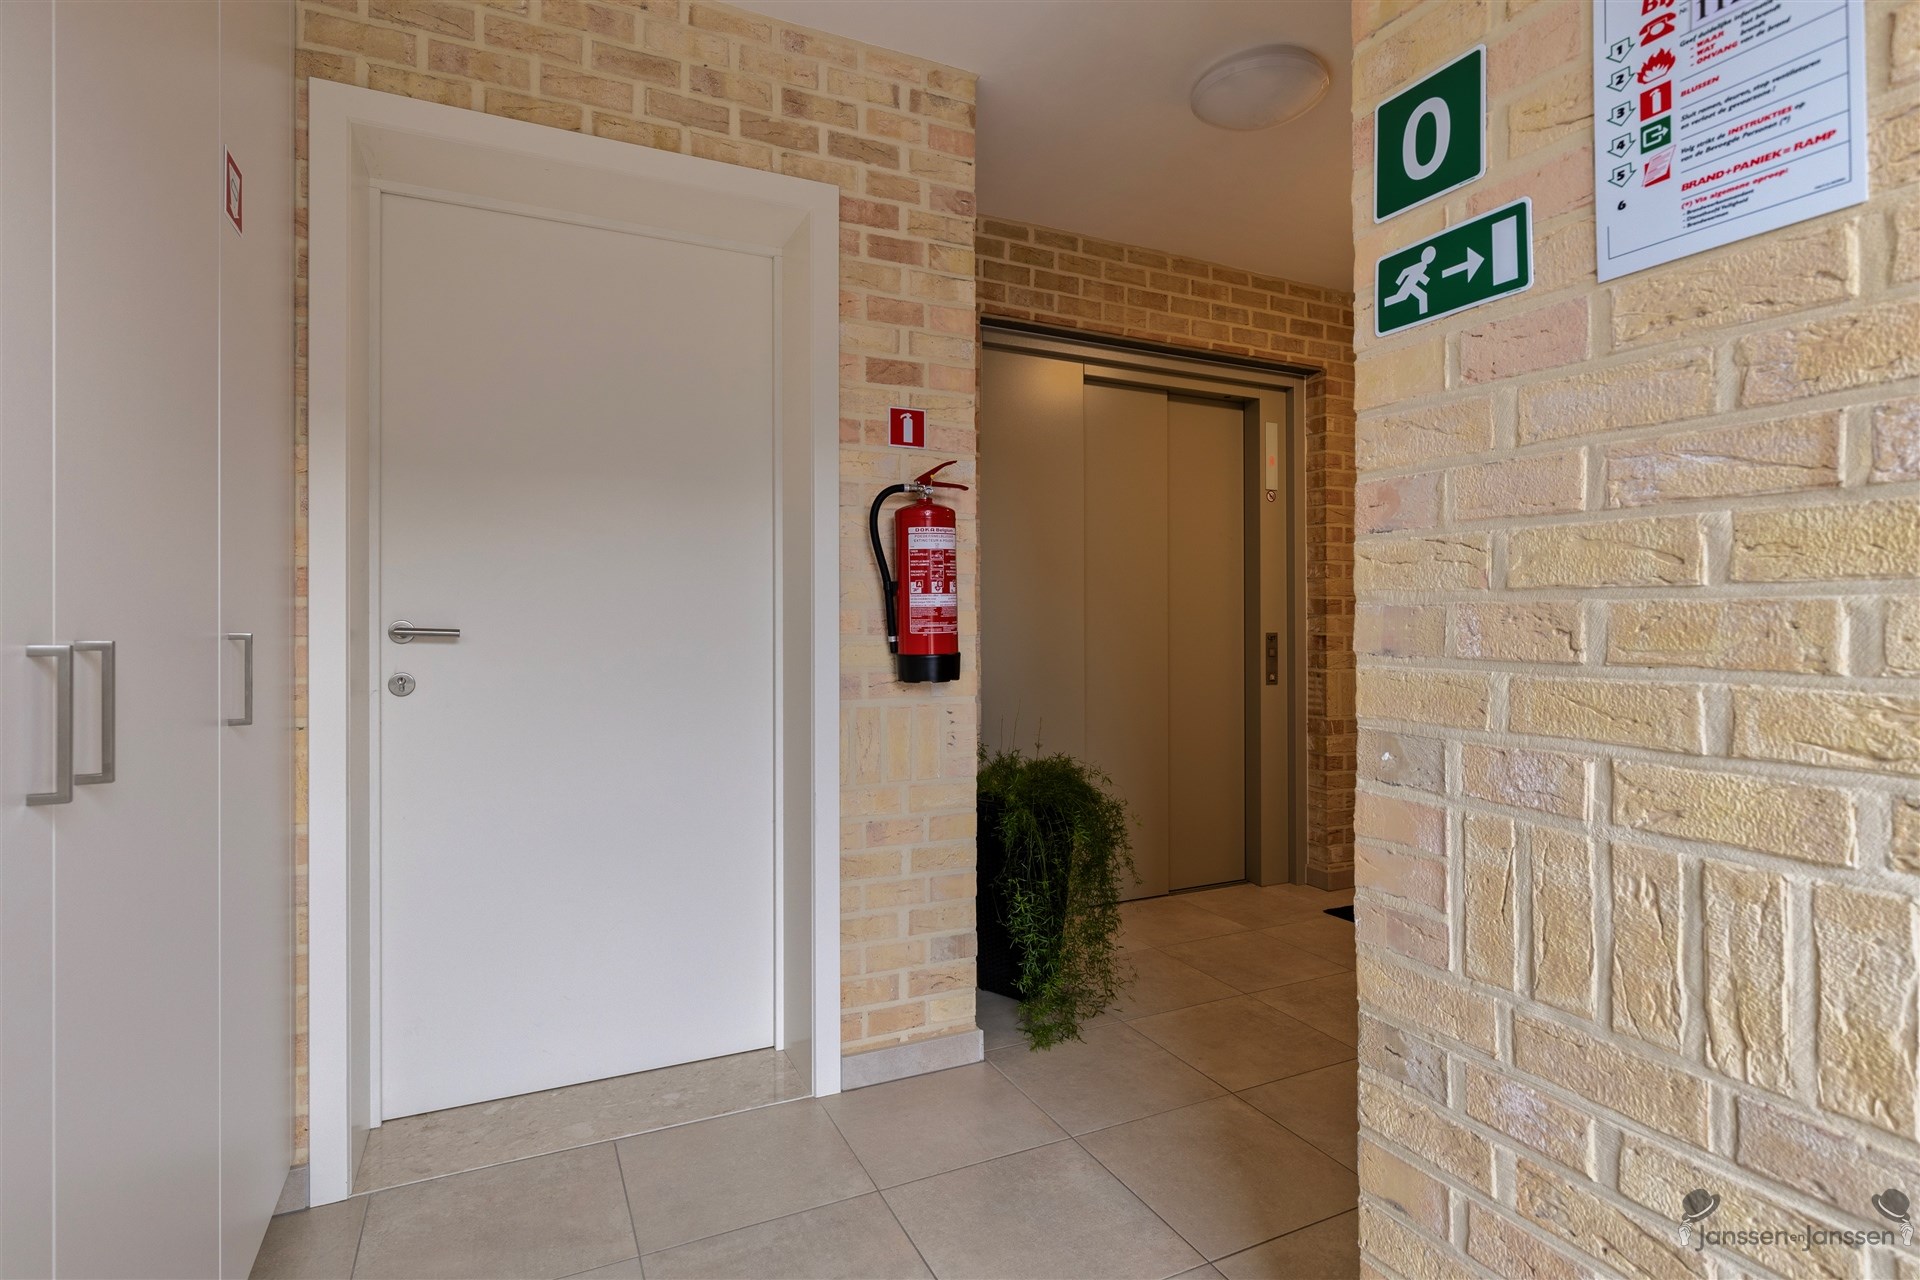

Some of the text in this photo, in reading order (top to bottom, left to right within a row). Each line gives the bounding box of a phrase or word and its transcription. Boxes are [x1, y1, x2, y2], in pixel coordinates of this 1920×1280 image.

[1680, 34, 1697, 47] Geef
[1698, 19, 1732, 38] duidelijke
[1697, 30, 1724, 47] WAAR
[1755, 4, 1781, 20] brandt
[1697, 20, 1765, 56] WAT brandt
[1697, 41, 1738, 64] OMVANG
[1756, 29, 1765, 37] de
[1767, 14, 1791, 31] brand
[1616, 45, 1623, 55] 1
[1615, 74, 1624, 86] 2
[1680, 75, 1720, 97] BLUSSEN
[1616, 107, 1625, 119] 3
[1402, 97, 1450, 180] 0
[1681, 145, 1695, 154] Volg
[1717, 132, 1726, 140] de
[1728, 105, 1793, 136] INSTRUKTIES
[1705, 136, 1740, 153] Bevoegde
[1742, 121, 1778, 139] Personen
[1793, 128, 1837, 152] RAMP
[1616, 139, 1625, 151] 4
[1616, 169, 1625, 182] 5
[1617, 200, 1627, 211] 6
[1695, 196, 1707, 204] Via
